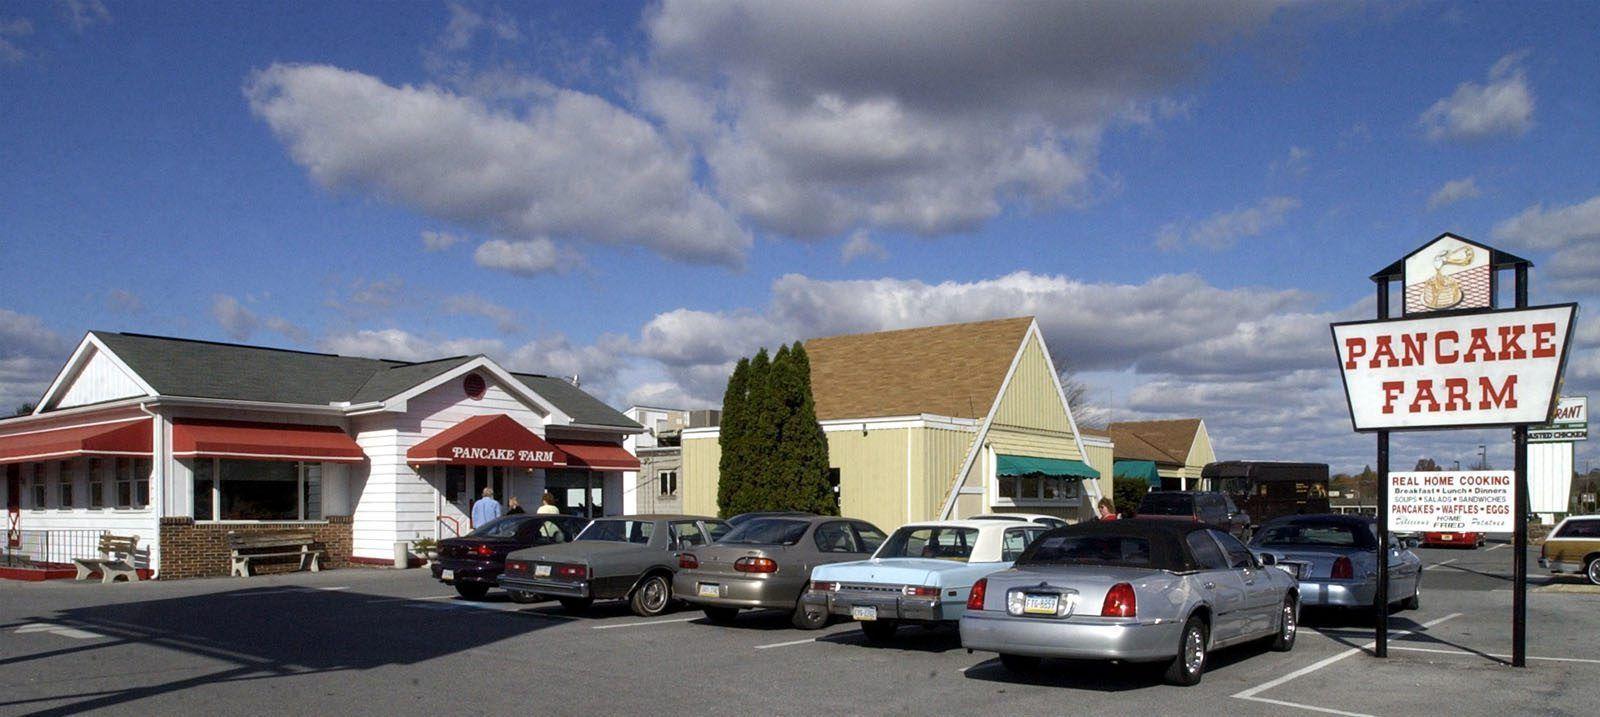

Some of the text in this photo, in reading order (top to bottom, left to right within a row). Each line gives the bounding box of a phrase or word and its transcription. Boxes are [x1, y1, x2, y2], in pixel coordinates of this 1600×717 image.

[1345, 322, 1556, 370] PANCAKE
[1382, 374, 1518, 414] FARM
[1554, 431, 1588, 439] CHICKEN
[452, 446, 554, 462] PANCAKE FARM
[1392, 475, 1510, 486] REAL HOME COOKING
[1392, 505, 1510, 514] PANCAKES WAFFLES EGGS
